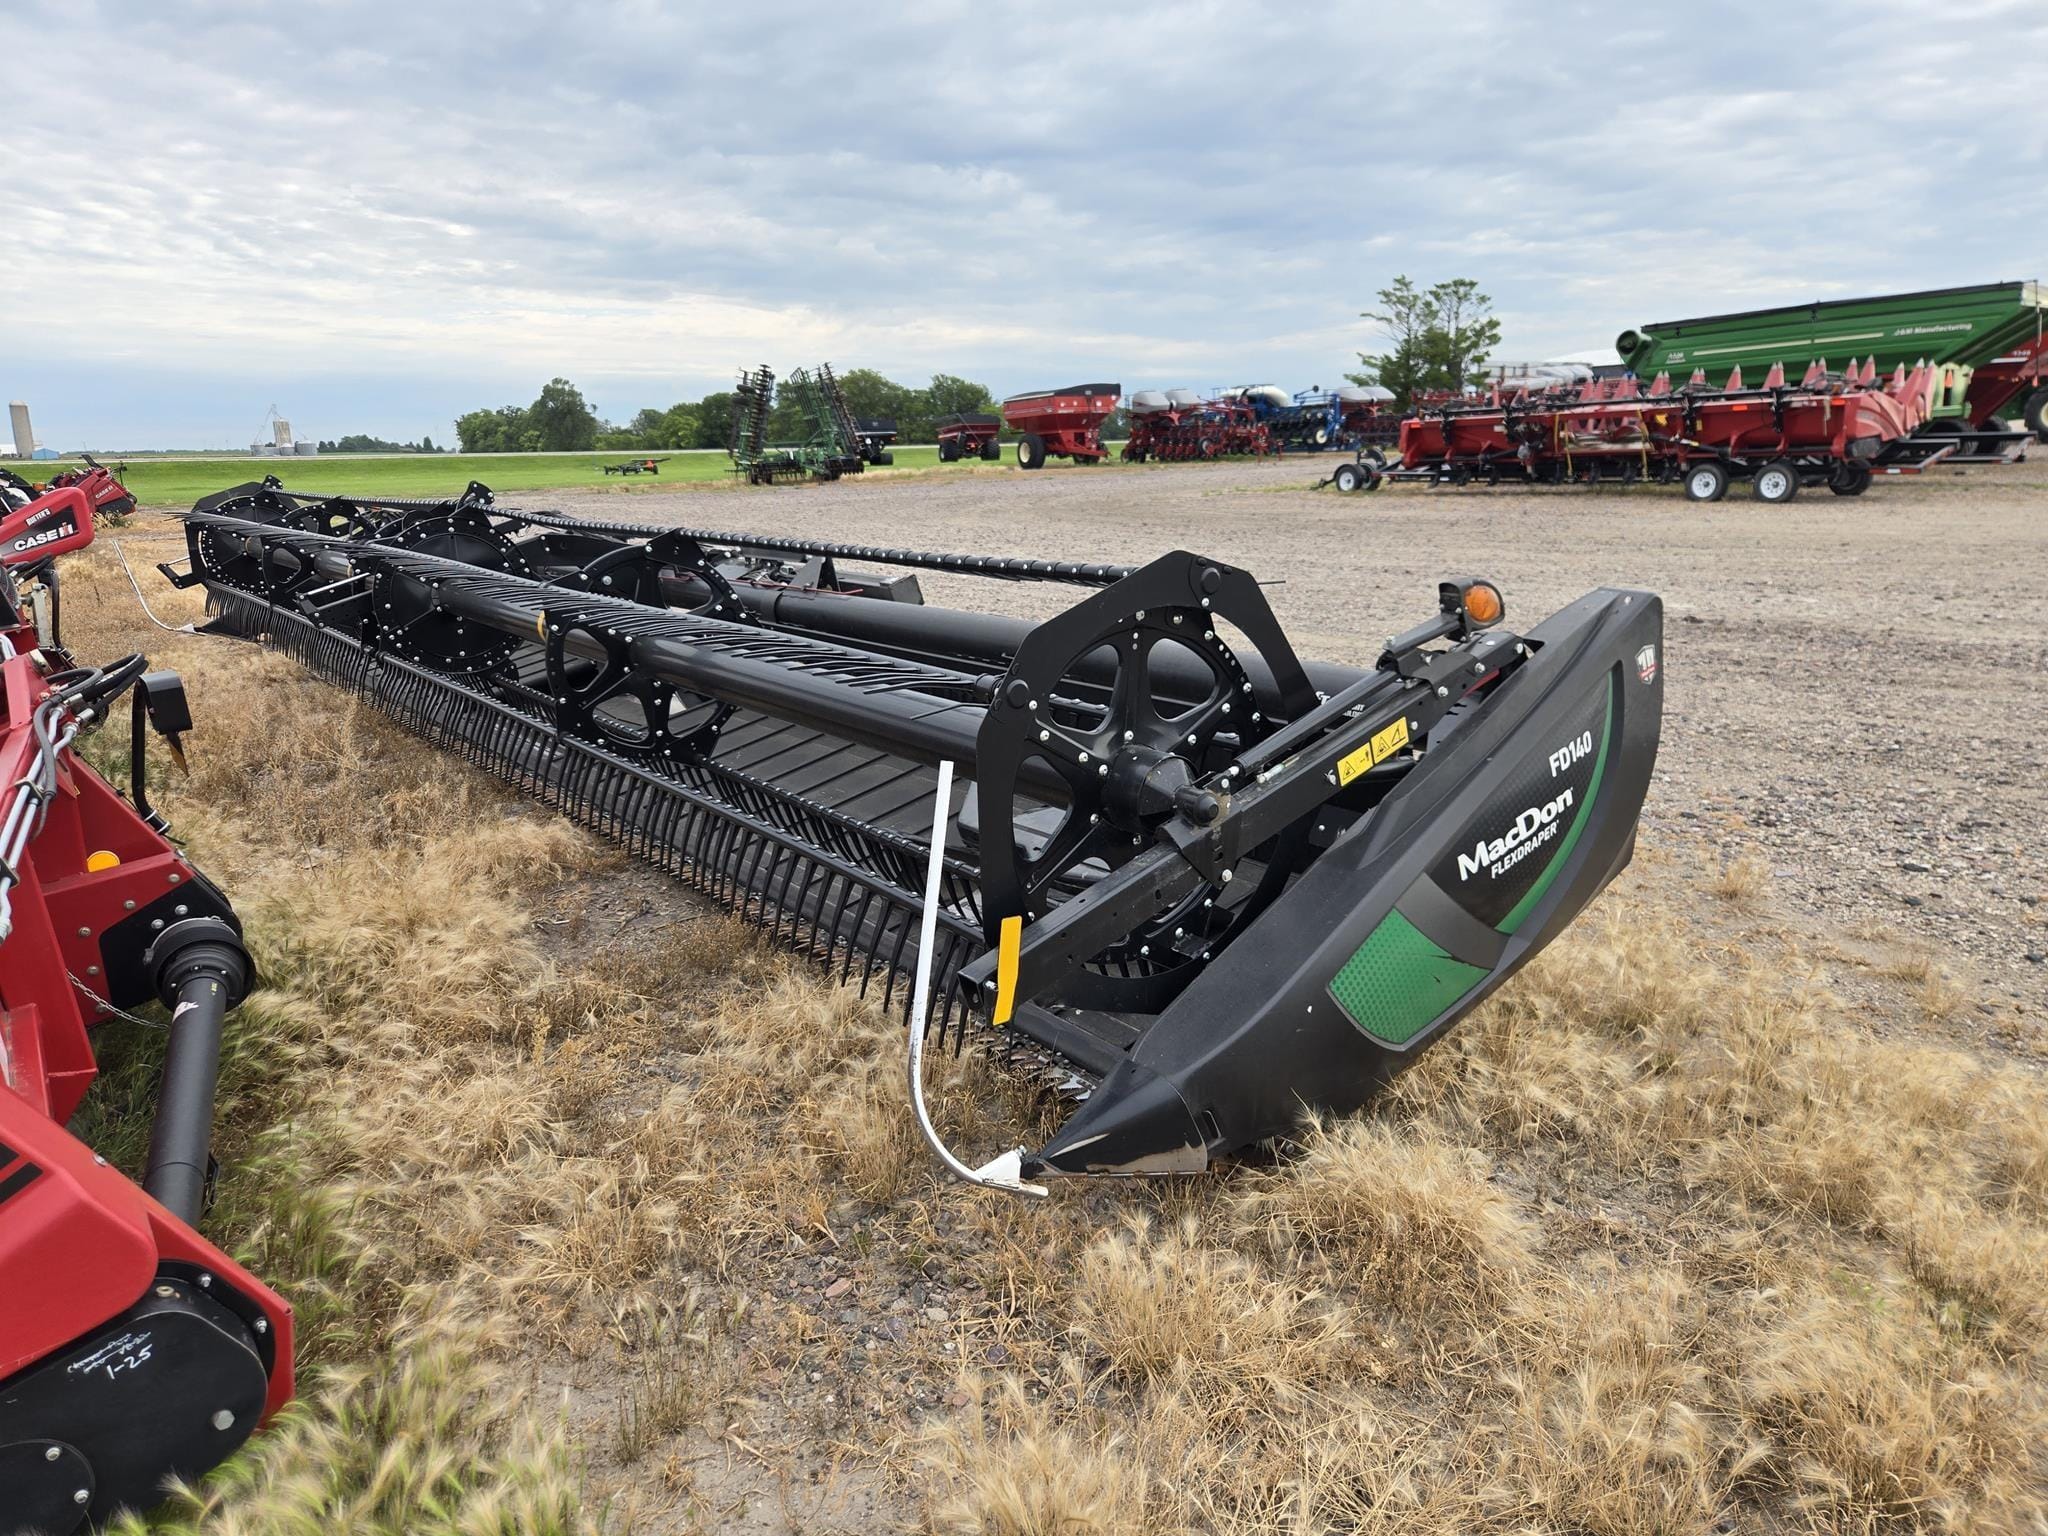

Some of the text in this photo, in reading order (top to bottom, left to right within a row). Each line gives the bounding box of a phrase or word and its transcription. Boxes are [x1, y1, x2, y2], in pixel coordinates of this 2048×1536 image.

[95, 487, 109, 499] CASE
[14, 529, 58, 551] CASE
[1549, 731, 1592, 777] FD140
[1457, 788, 1574, 881] MacDon
[1491, 822, 1558, 879] FLEXDRAPER
[106, 1343, 153, 1380] 1-25
